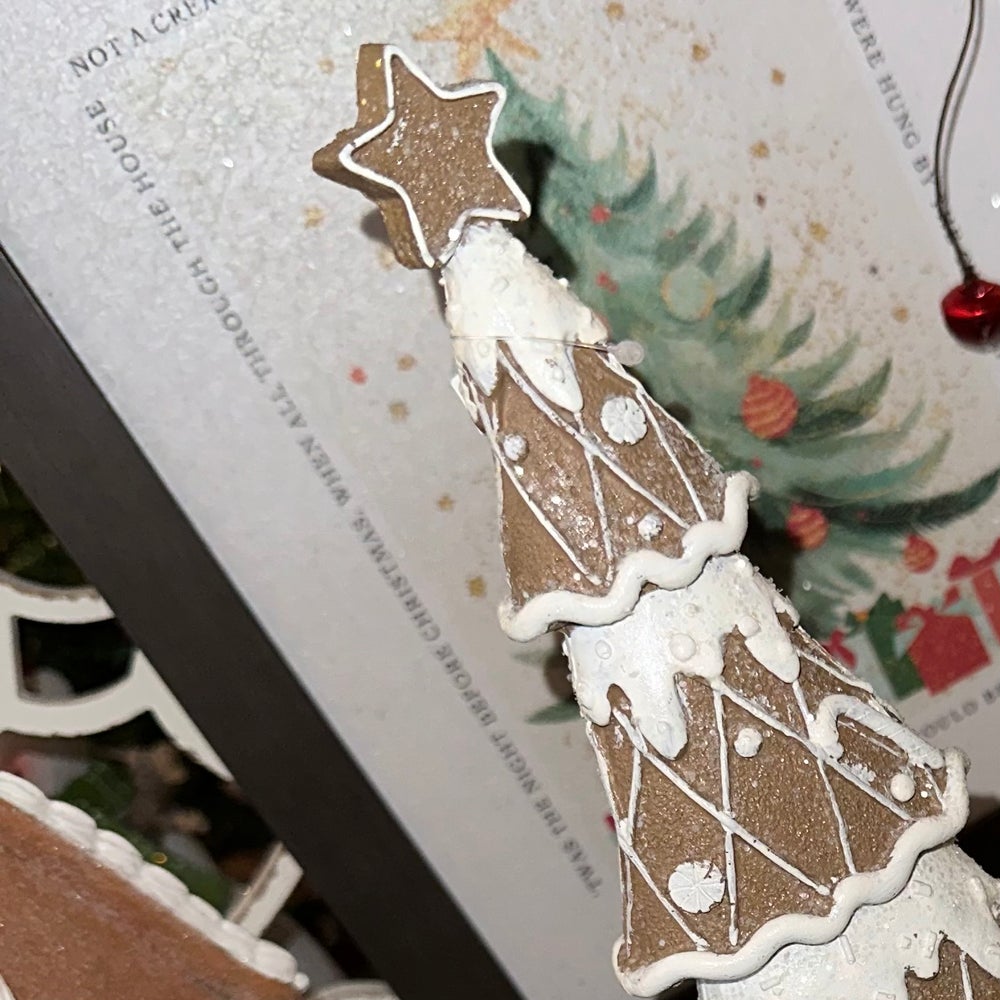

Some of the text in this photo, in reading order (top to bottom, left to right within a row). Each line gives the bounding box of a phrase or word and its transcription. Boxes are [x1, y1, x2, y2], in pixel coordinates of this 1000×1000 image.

[68, 37, 123, 78] NOT
[130, 26, 147, 47] A
[876, 73, 922, 150] HUNG
[84, 98, 156, 195] HOUSE
[147, 198, 190, 254] THE
[186, 255, 272, 383] THROUGH
[269, 382, 307, 430] ALL
[298, 434, 352, 507] WHEN
[433, 644, 497, 728] BEFORE
[489, 731, 541, 796] NIGHT
[533, 796, 568, 837] THE
